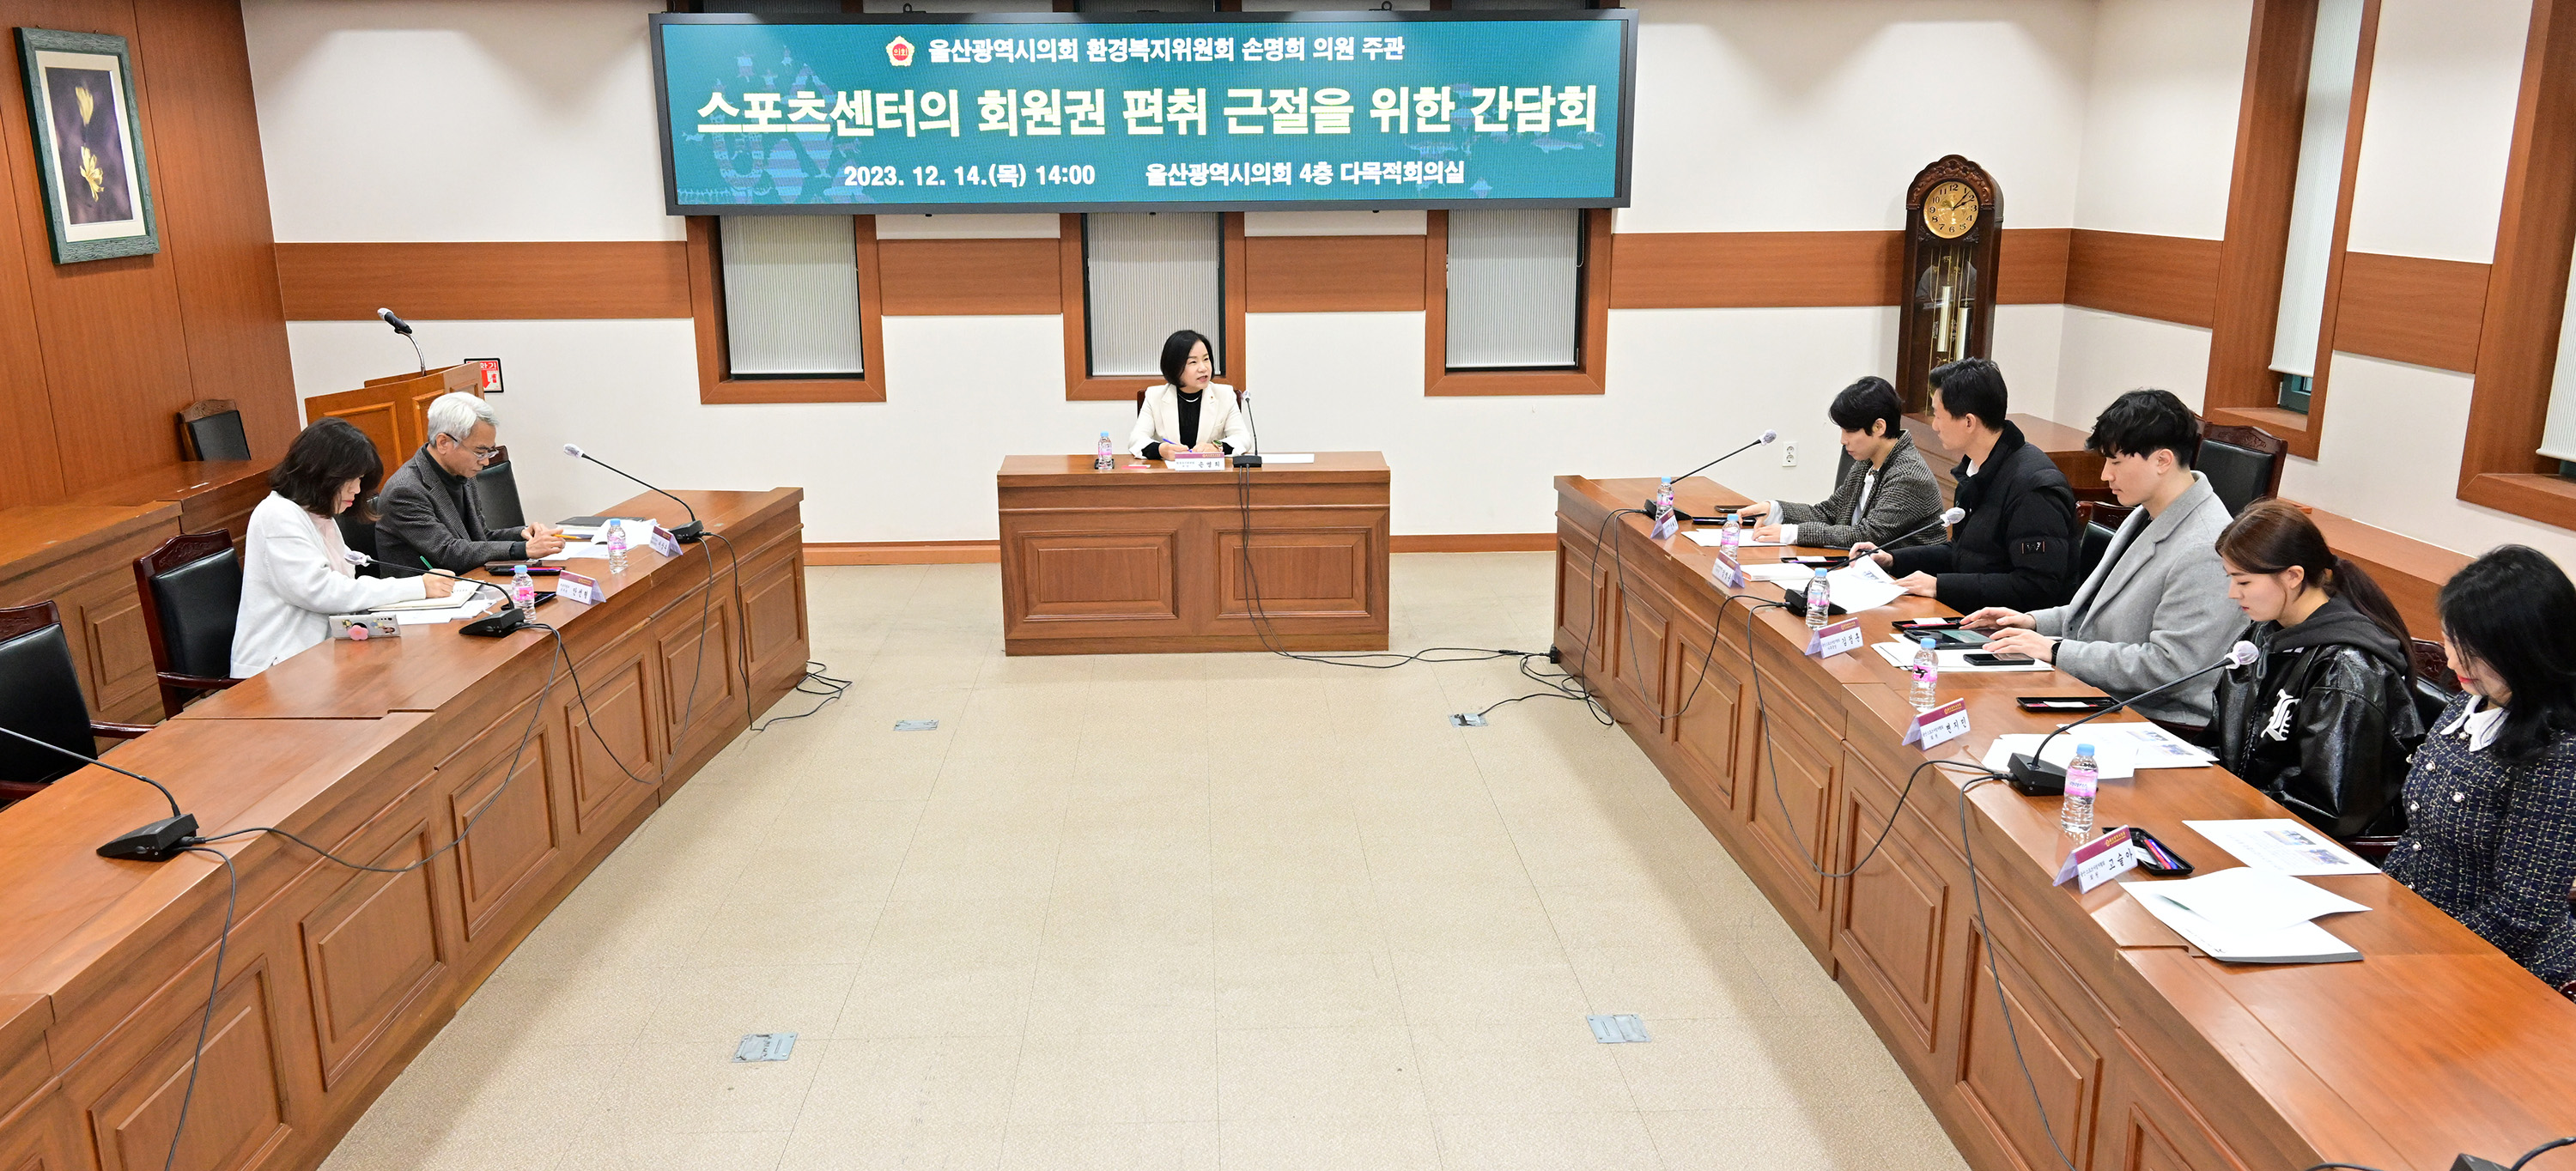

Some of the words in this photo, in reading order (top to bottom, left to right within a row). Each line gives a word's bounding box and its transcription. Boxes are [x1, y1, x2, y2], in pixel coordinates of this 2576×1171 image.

[929, 38, 1078, 64] 울산광역시의회
[1086, 37, 1234, 63] 환경복지위원회
[1242, 36, 1305, 62] 손명희
[1312, 36, 1355, 61] 의원
[1361, 36, 1406, 61] 주관
[697, 88, 960, 137] 스포츠센터의
[977, 88, 1106, 137] 회원권
[1122, 88, 1206, 136] 편취
[1223, 87, 1354, 135] 근절을
[1370, 86, 1455, 134] 위한
[1470, 85, 1597, 133] 간담회
[843, 165, 904, 186] 2023.
[913, 165, 945, 186] 12.
[954, 163, 1026, 188] 14.(목)
[1036, 164, 1096, 186] 14:00
[1145, 161, 1291, 186] 울산광역시의회
[1299, 161, 1334, 185] 4층
[1340, 160, 1465, 185] 다목적회의실
[1949, 183, 1959, 191] 12
